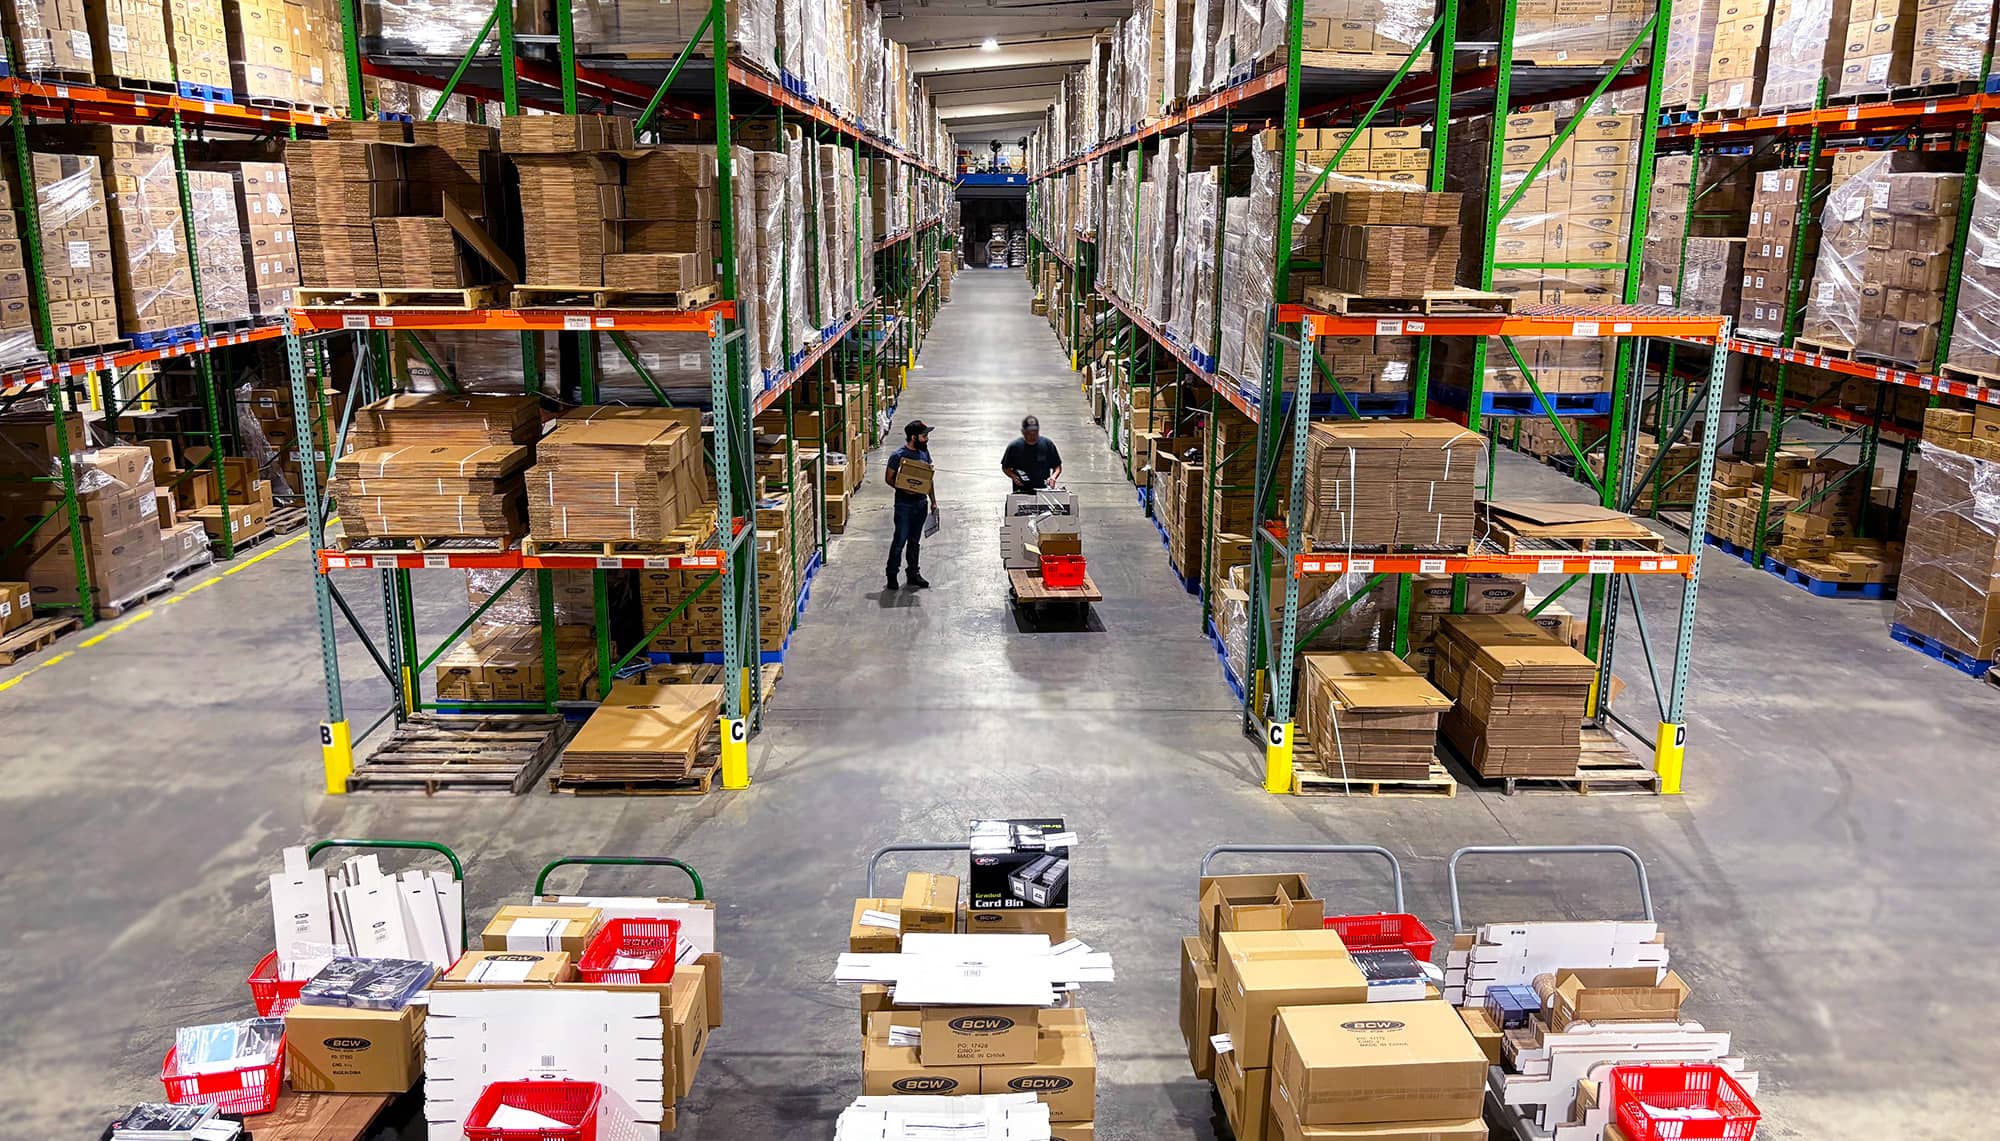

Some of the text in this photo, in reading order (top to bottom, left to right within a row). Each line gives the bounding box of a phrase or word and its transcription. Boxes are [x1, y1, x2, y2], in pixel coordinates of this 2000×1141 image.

[320, 725, 331, 744] B
[732, 721, 743, 740] C
[1270, 726, 1282, 744] C
[1676, 727, 1685, 746] D
[975, 899, 1024, 907] Card Bin
[961, 1020, 1001, 1029] BCW
[905, 1080, 945, 1089] BCW
[1021, 1079, 1059, 1088] BCW
